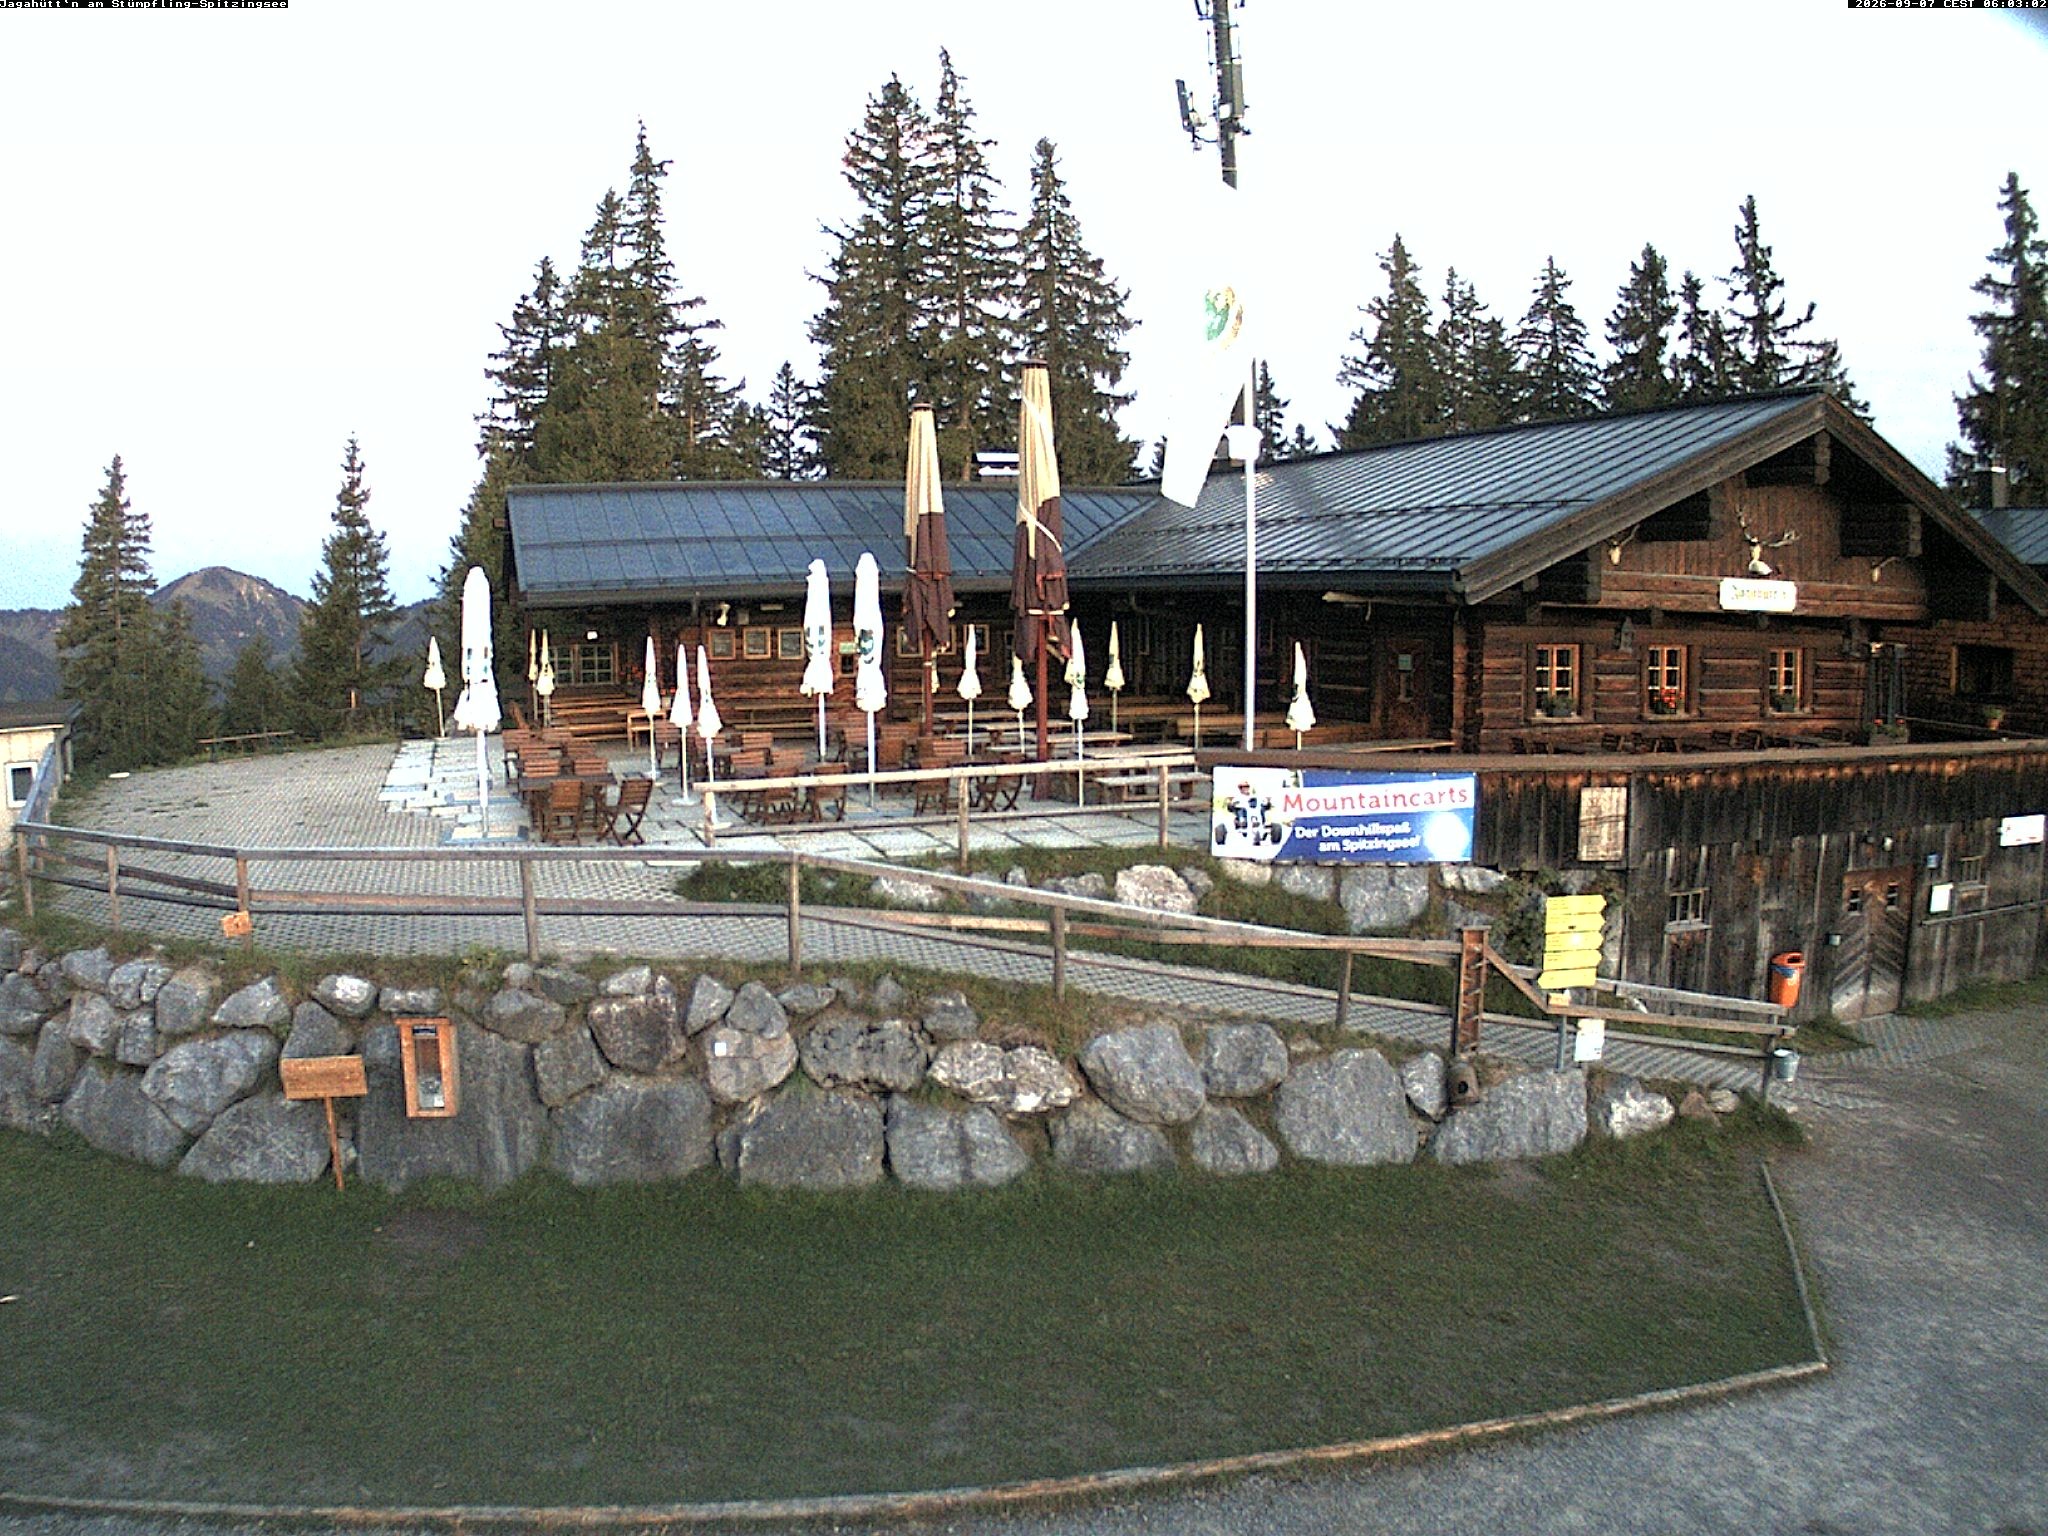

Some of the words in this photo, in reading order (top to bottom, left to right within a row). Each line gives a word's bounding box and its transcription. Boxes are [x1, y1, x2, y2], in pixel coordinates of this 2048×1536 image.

[1283, 788, 1467, 812] Mountaincarts
[1295, 827, 1319, 838] Der
[1319, 842, 1341, 851] am
